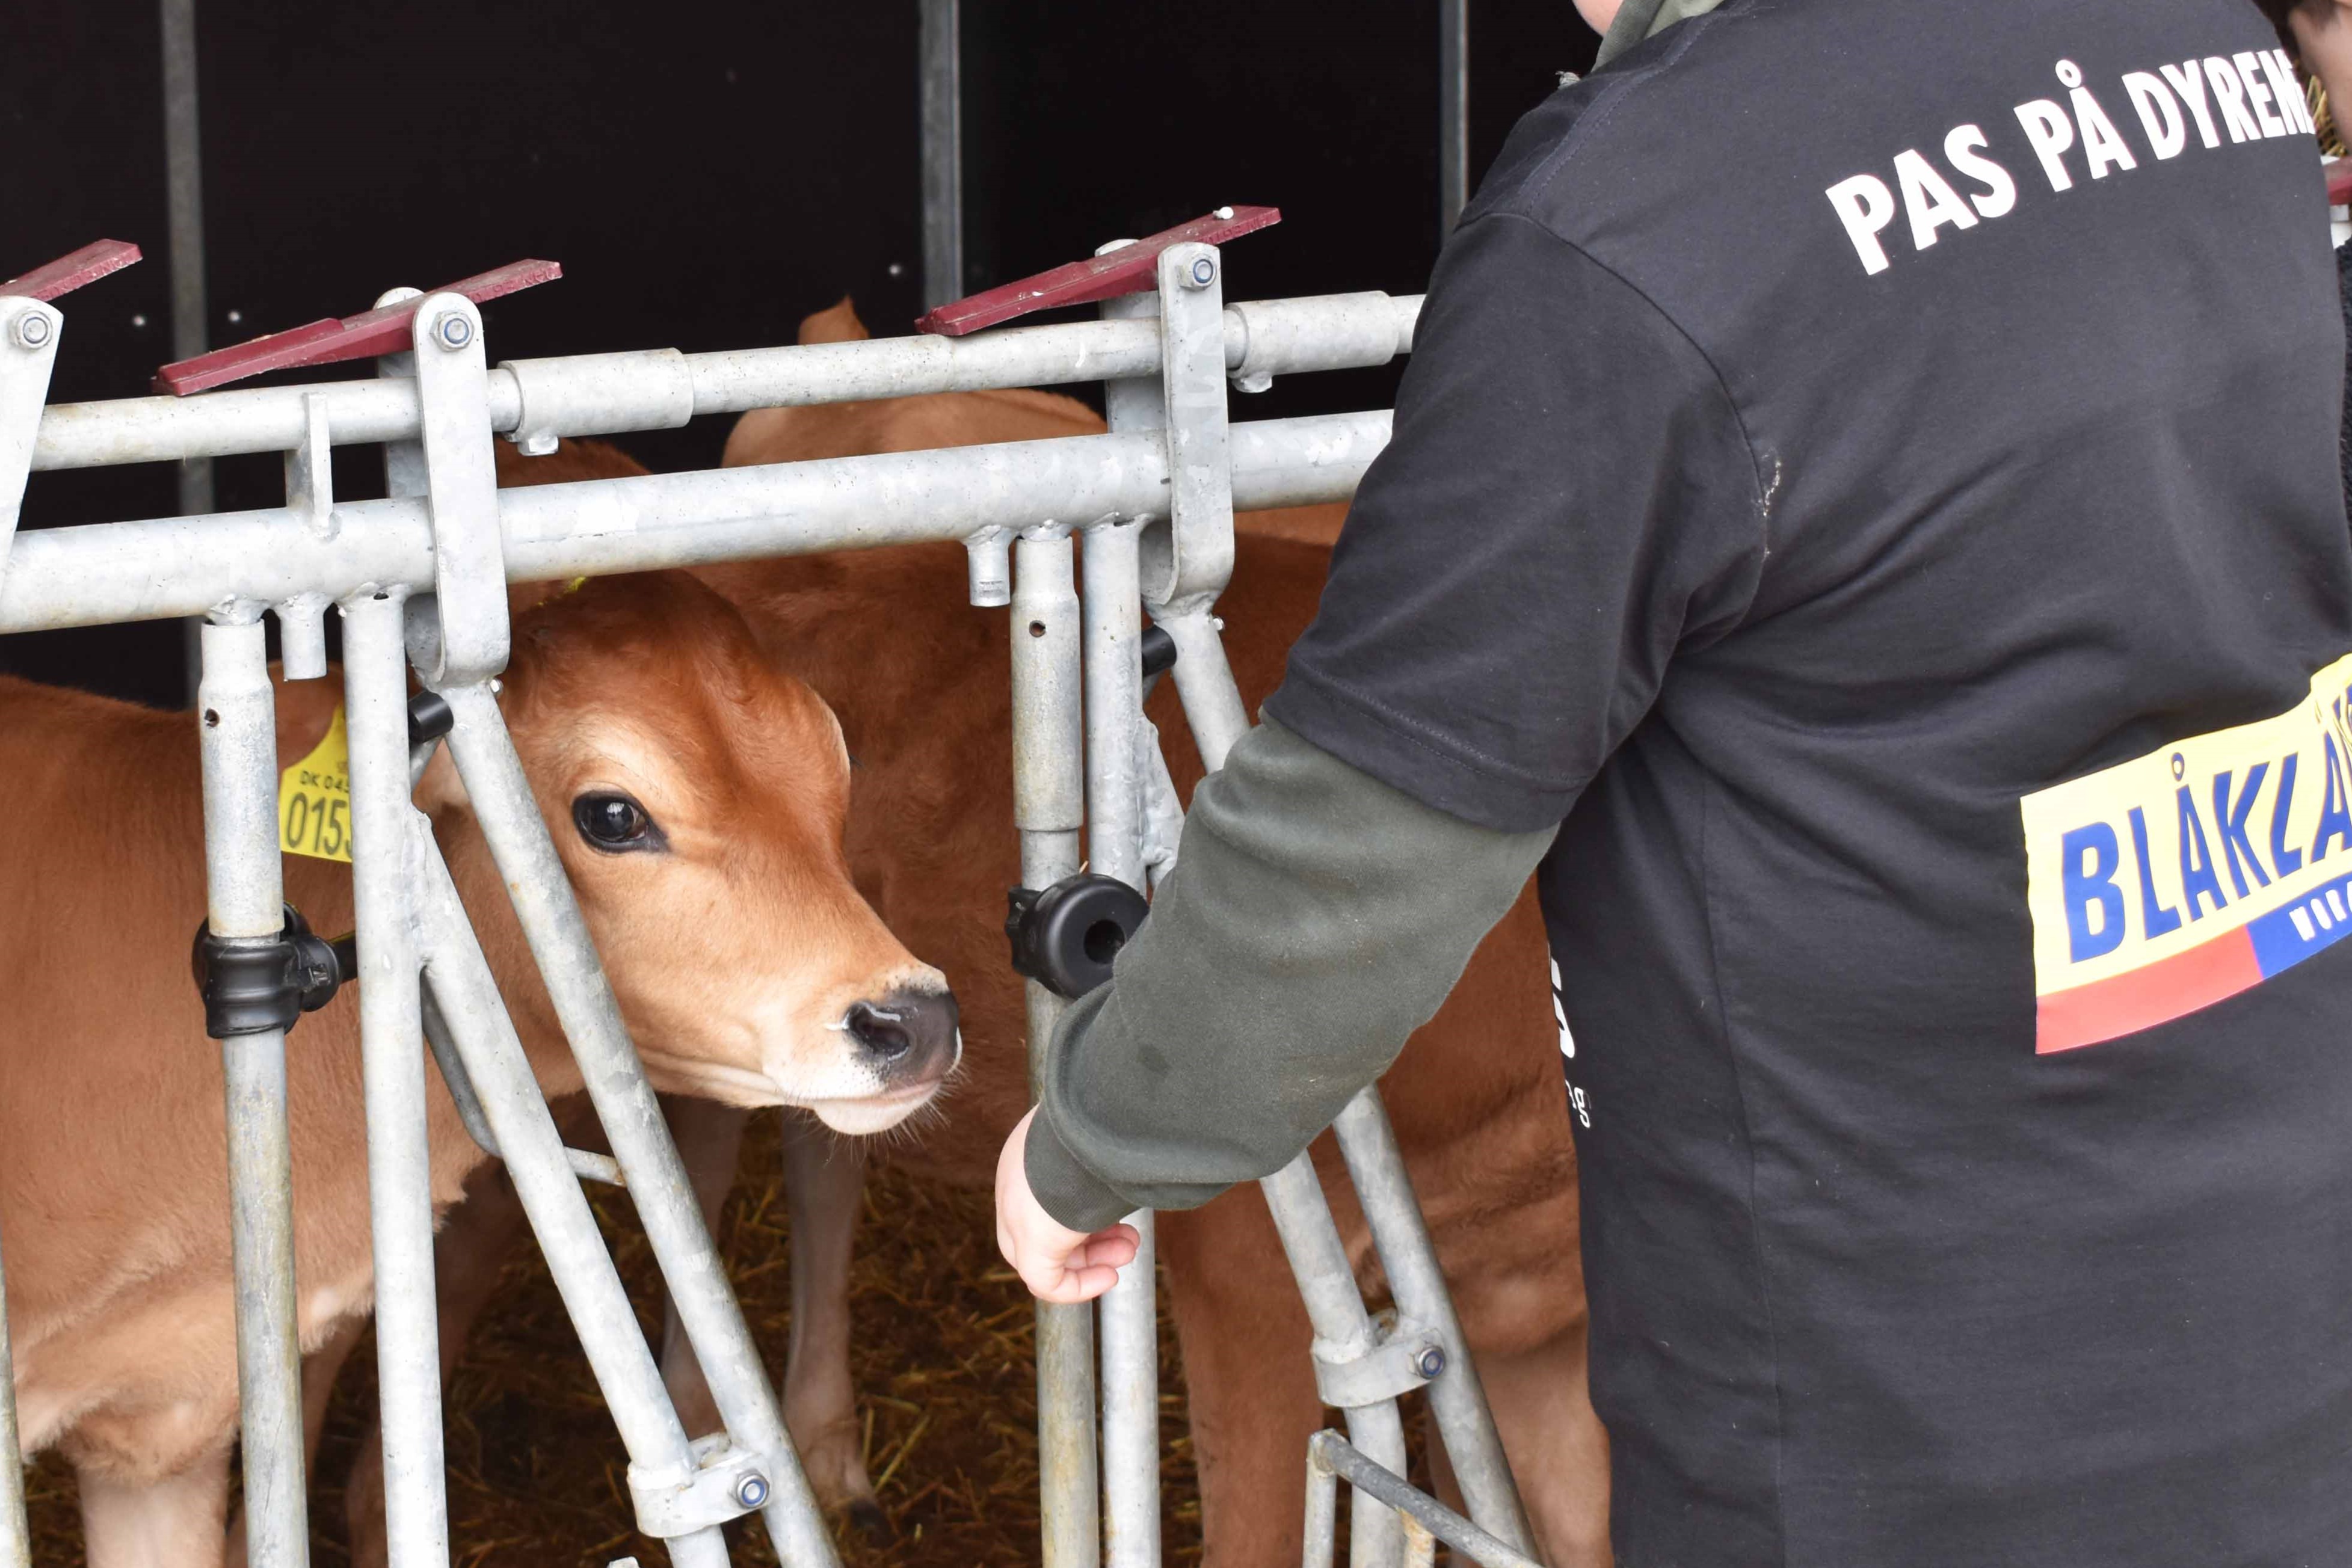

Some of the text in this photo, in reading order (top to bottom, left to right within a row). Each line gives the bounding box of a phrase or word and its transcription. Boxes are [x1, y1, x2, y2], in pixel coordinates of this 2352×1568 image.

[1824, 124, 2016, 276] PAS
[2013, 59, 2137, 192] PÅ
[300, 770, 319, 787] DK
[286, 792, 352, 859] 015
